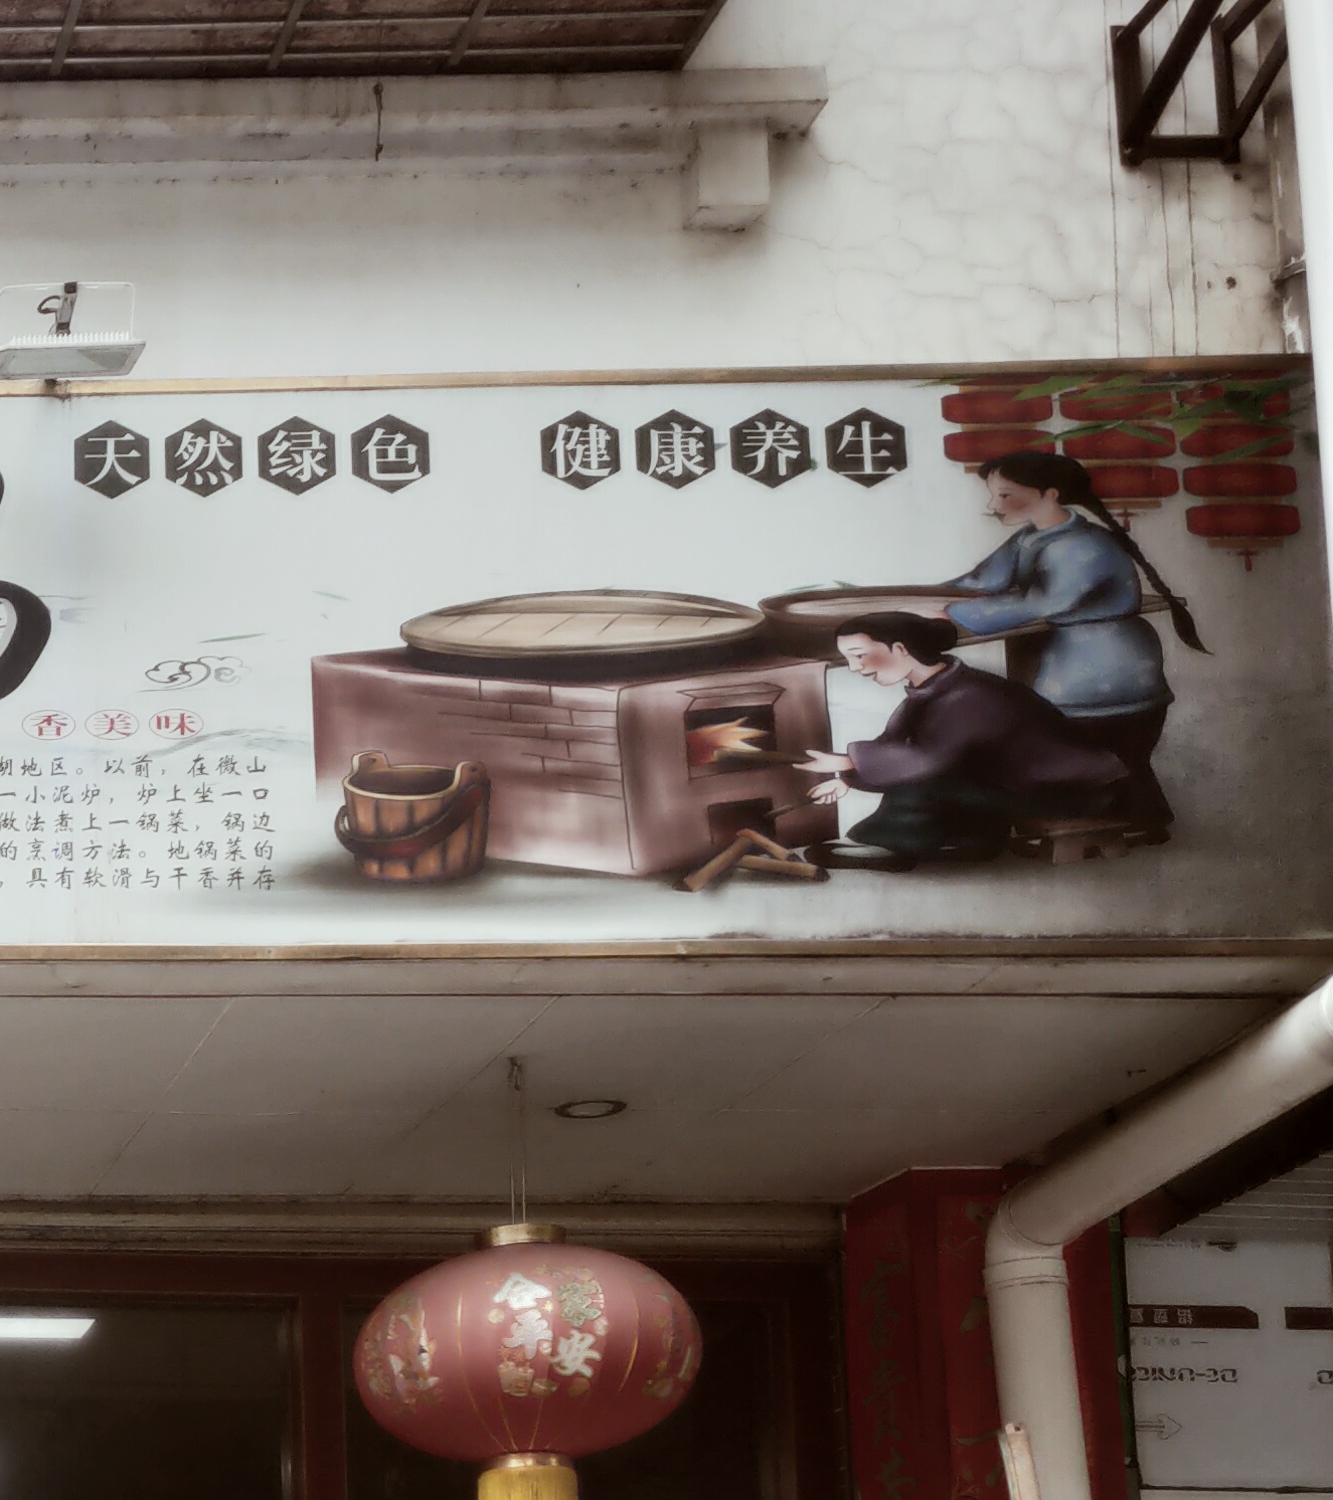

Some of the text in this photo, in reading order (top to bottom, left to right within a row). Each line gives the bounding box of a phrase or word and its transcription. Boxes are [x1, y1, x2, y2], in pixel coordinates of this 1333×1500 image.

[85, 420, 898, 487] 天然绿色 健康养生
[31, 713, 197, 737] 香美味
